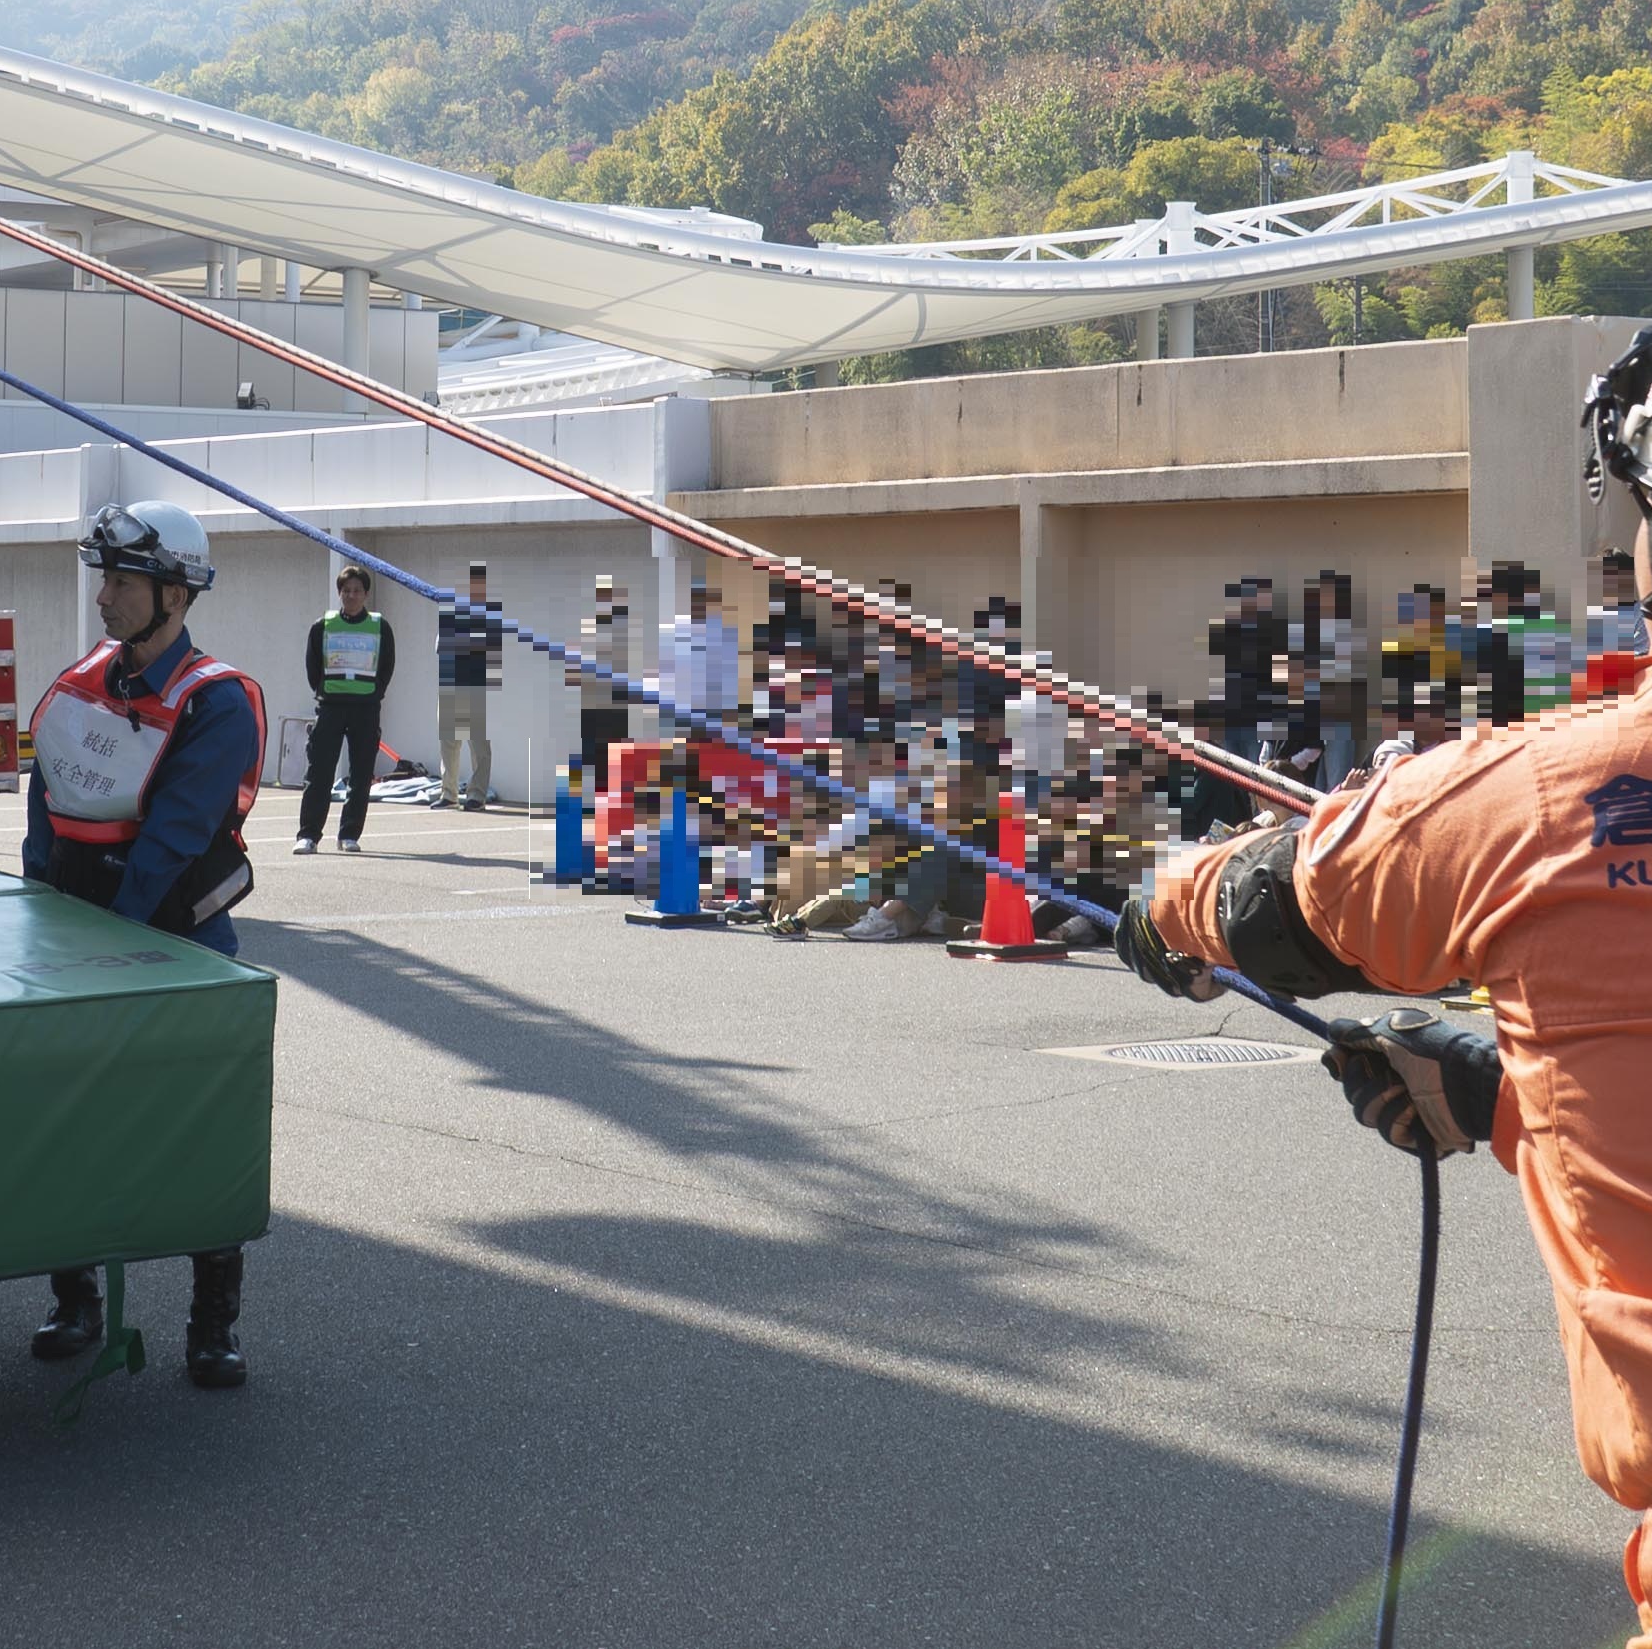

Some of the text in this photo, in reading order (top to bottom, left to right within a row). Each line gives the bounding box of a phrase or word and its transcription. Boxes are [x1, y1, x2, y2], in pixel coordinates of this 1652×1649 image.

[82, 729, 119, 759] 統括
[52, 757, 117, 798] 安全管理
